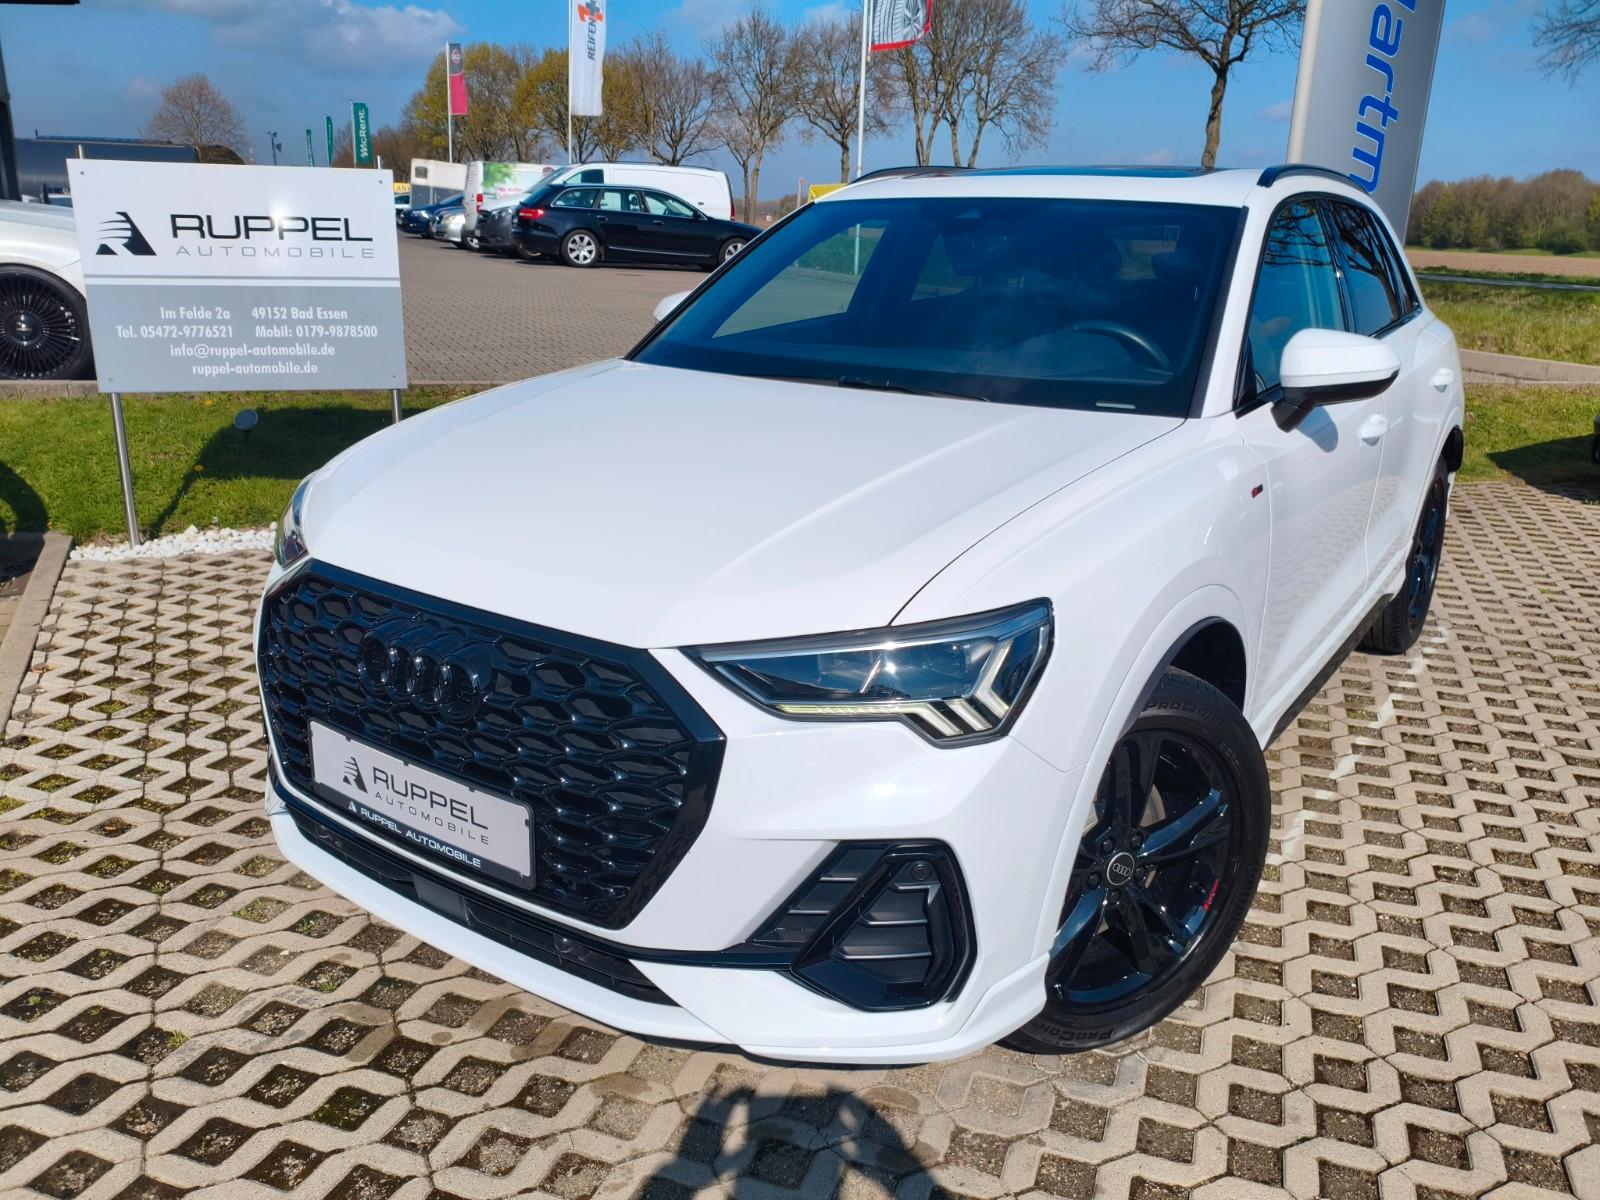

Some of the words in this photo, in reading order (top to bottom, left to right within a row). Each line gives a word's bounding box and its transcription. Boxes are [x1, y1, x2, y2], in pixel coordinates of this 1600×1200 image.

[359, 108, 369, 159] McRent
[170, 213, 373, 242] RUPPEL
[175, 245, 375, 260] AUTOMOBILE
[160, 306, 177, 320] Im
[179, 306, 213, 320] Felde
[215, 306, 231, 320] 2a
[251, 306, 288, 320] 49152
[290, 306, 314, 320] Bad
[316, 306, 348, 320] Essen
[115, 324, 138, 339] Tel.
[140, 324, 233, 339] 05472-9776521
[255, 324, 293, 338] Mobil:
[295, 324, 378, 338] 0179-9878500
[169, 342, 336, 359] info@ruppel-automobile.de
[192, 360, 319, 377] ruppel-automobile.de
[372, 766, 489, 831] RUPPEL
[374, 791, 490, 846] AUTOMOBILE
[360, 807, 402, 834] RUPPEL
[405, 827, 482, 869] AUTOMOBILE
